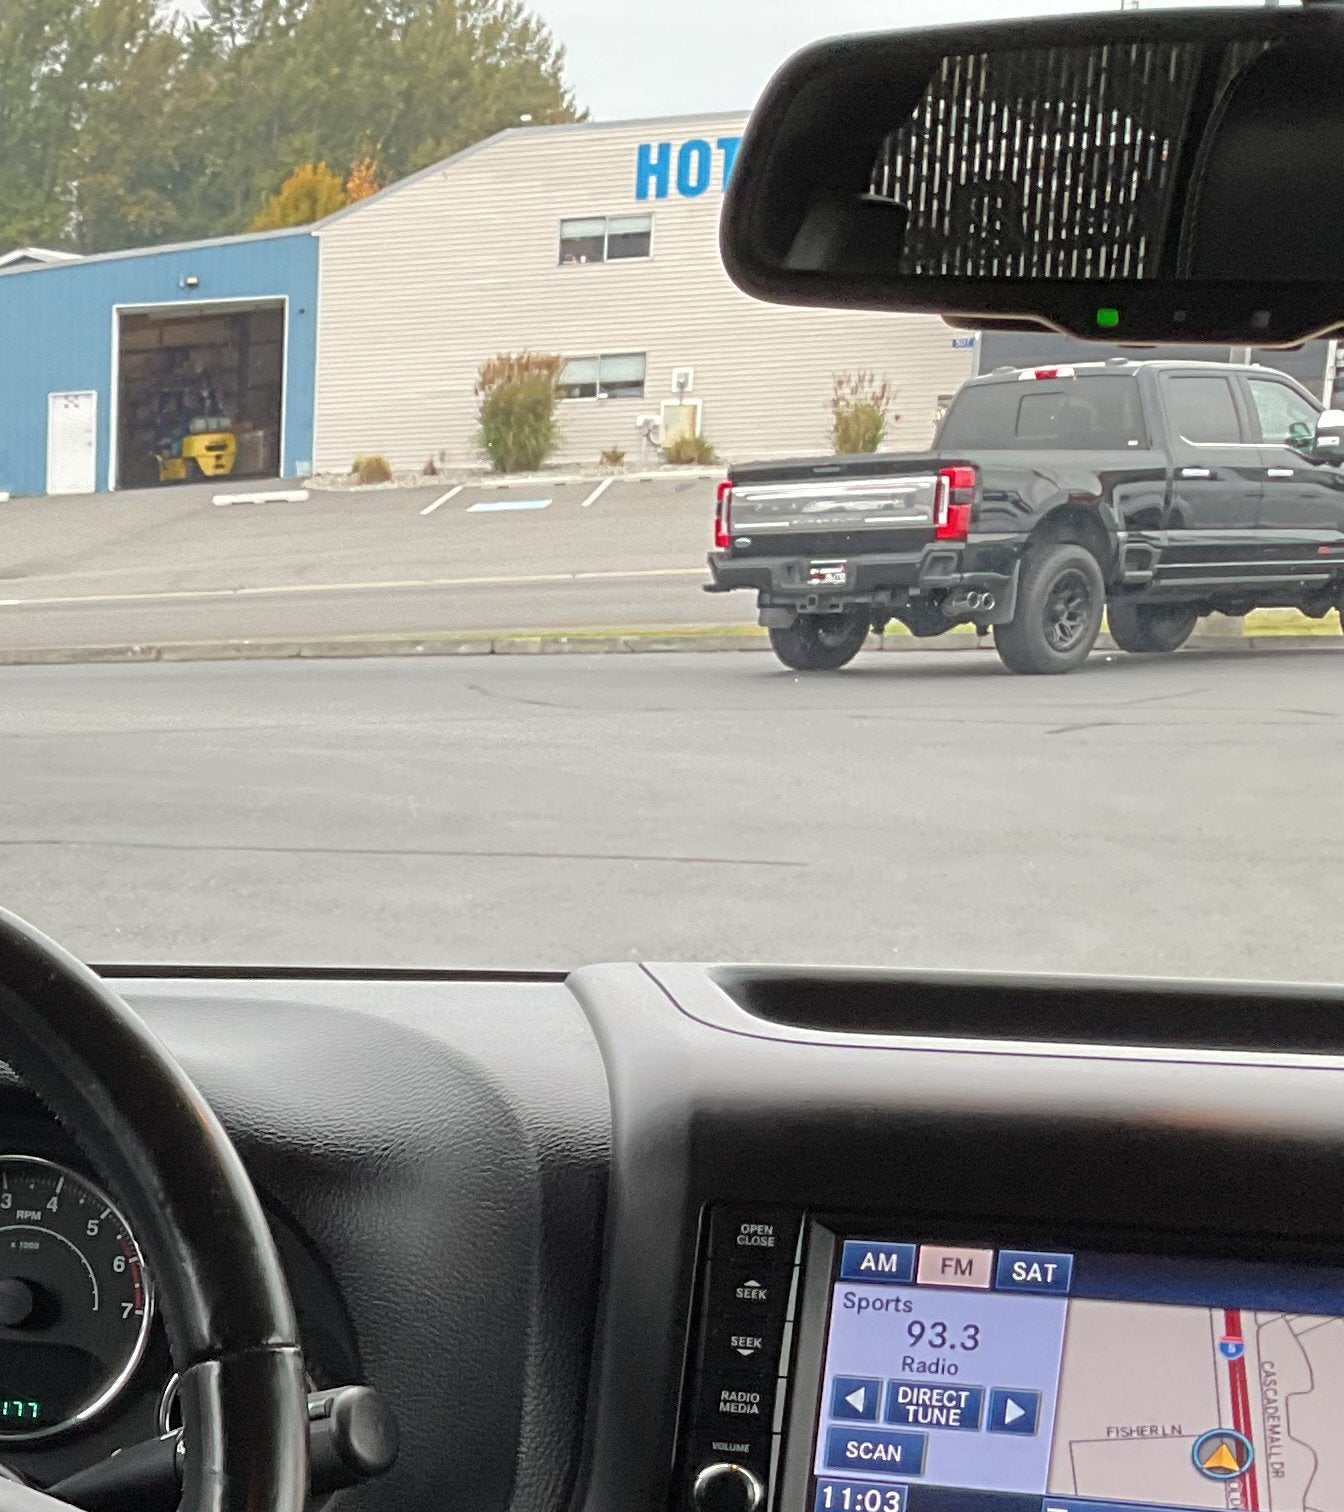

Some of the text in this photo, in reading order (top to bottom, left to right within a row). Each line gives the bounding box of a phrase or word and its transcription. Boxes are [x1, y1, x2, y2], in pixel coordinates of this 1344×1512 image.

[635, 137, 742, 201] HOT
[0, 1193, 12, 1209] 3
[46, 1196, 58, 1212] 4
[16, 1210, 41, 1221] RPM
[86, 1219, 99, 1235] 5
[741, 1223, 774, 1235] OPEN
[737, 1235, 775, 1247] CLOSE
[113, 1256, 125, 1273] 6
[860, 1252, 898, 1272] AM
[940, 1257, 973, 1277] FM
[1012, 1262, 1057, 1283] SAT
[736, 1288, 767, 1299] SEEK
[121, 1303, 133, 1319] 7
[843, 1291, 913, 1315] Sports
[731, 1336, 762, 1348] SEEK
[907, 1320, 980, 1351] 93.3
[901, 1355, 959, 1376] Radio
[720, 1390, 760, 1402] RADIO
[897, 1386, 970, 1408] DIRECT
[719, 1402, 759, 1414] MEDIA
[905, 1405, 961, 1426] TUNE
[1106, 1424, 1182, 1437] FISHER LN
[712, 1441, 750, 1453] VOLUME
[846, 1441, 901, 1462] SCAN
